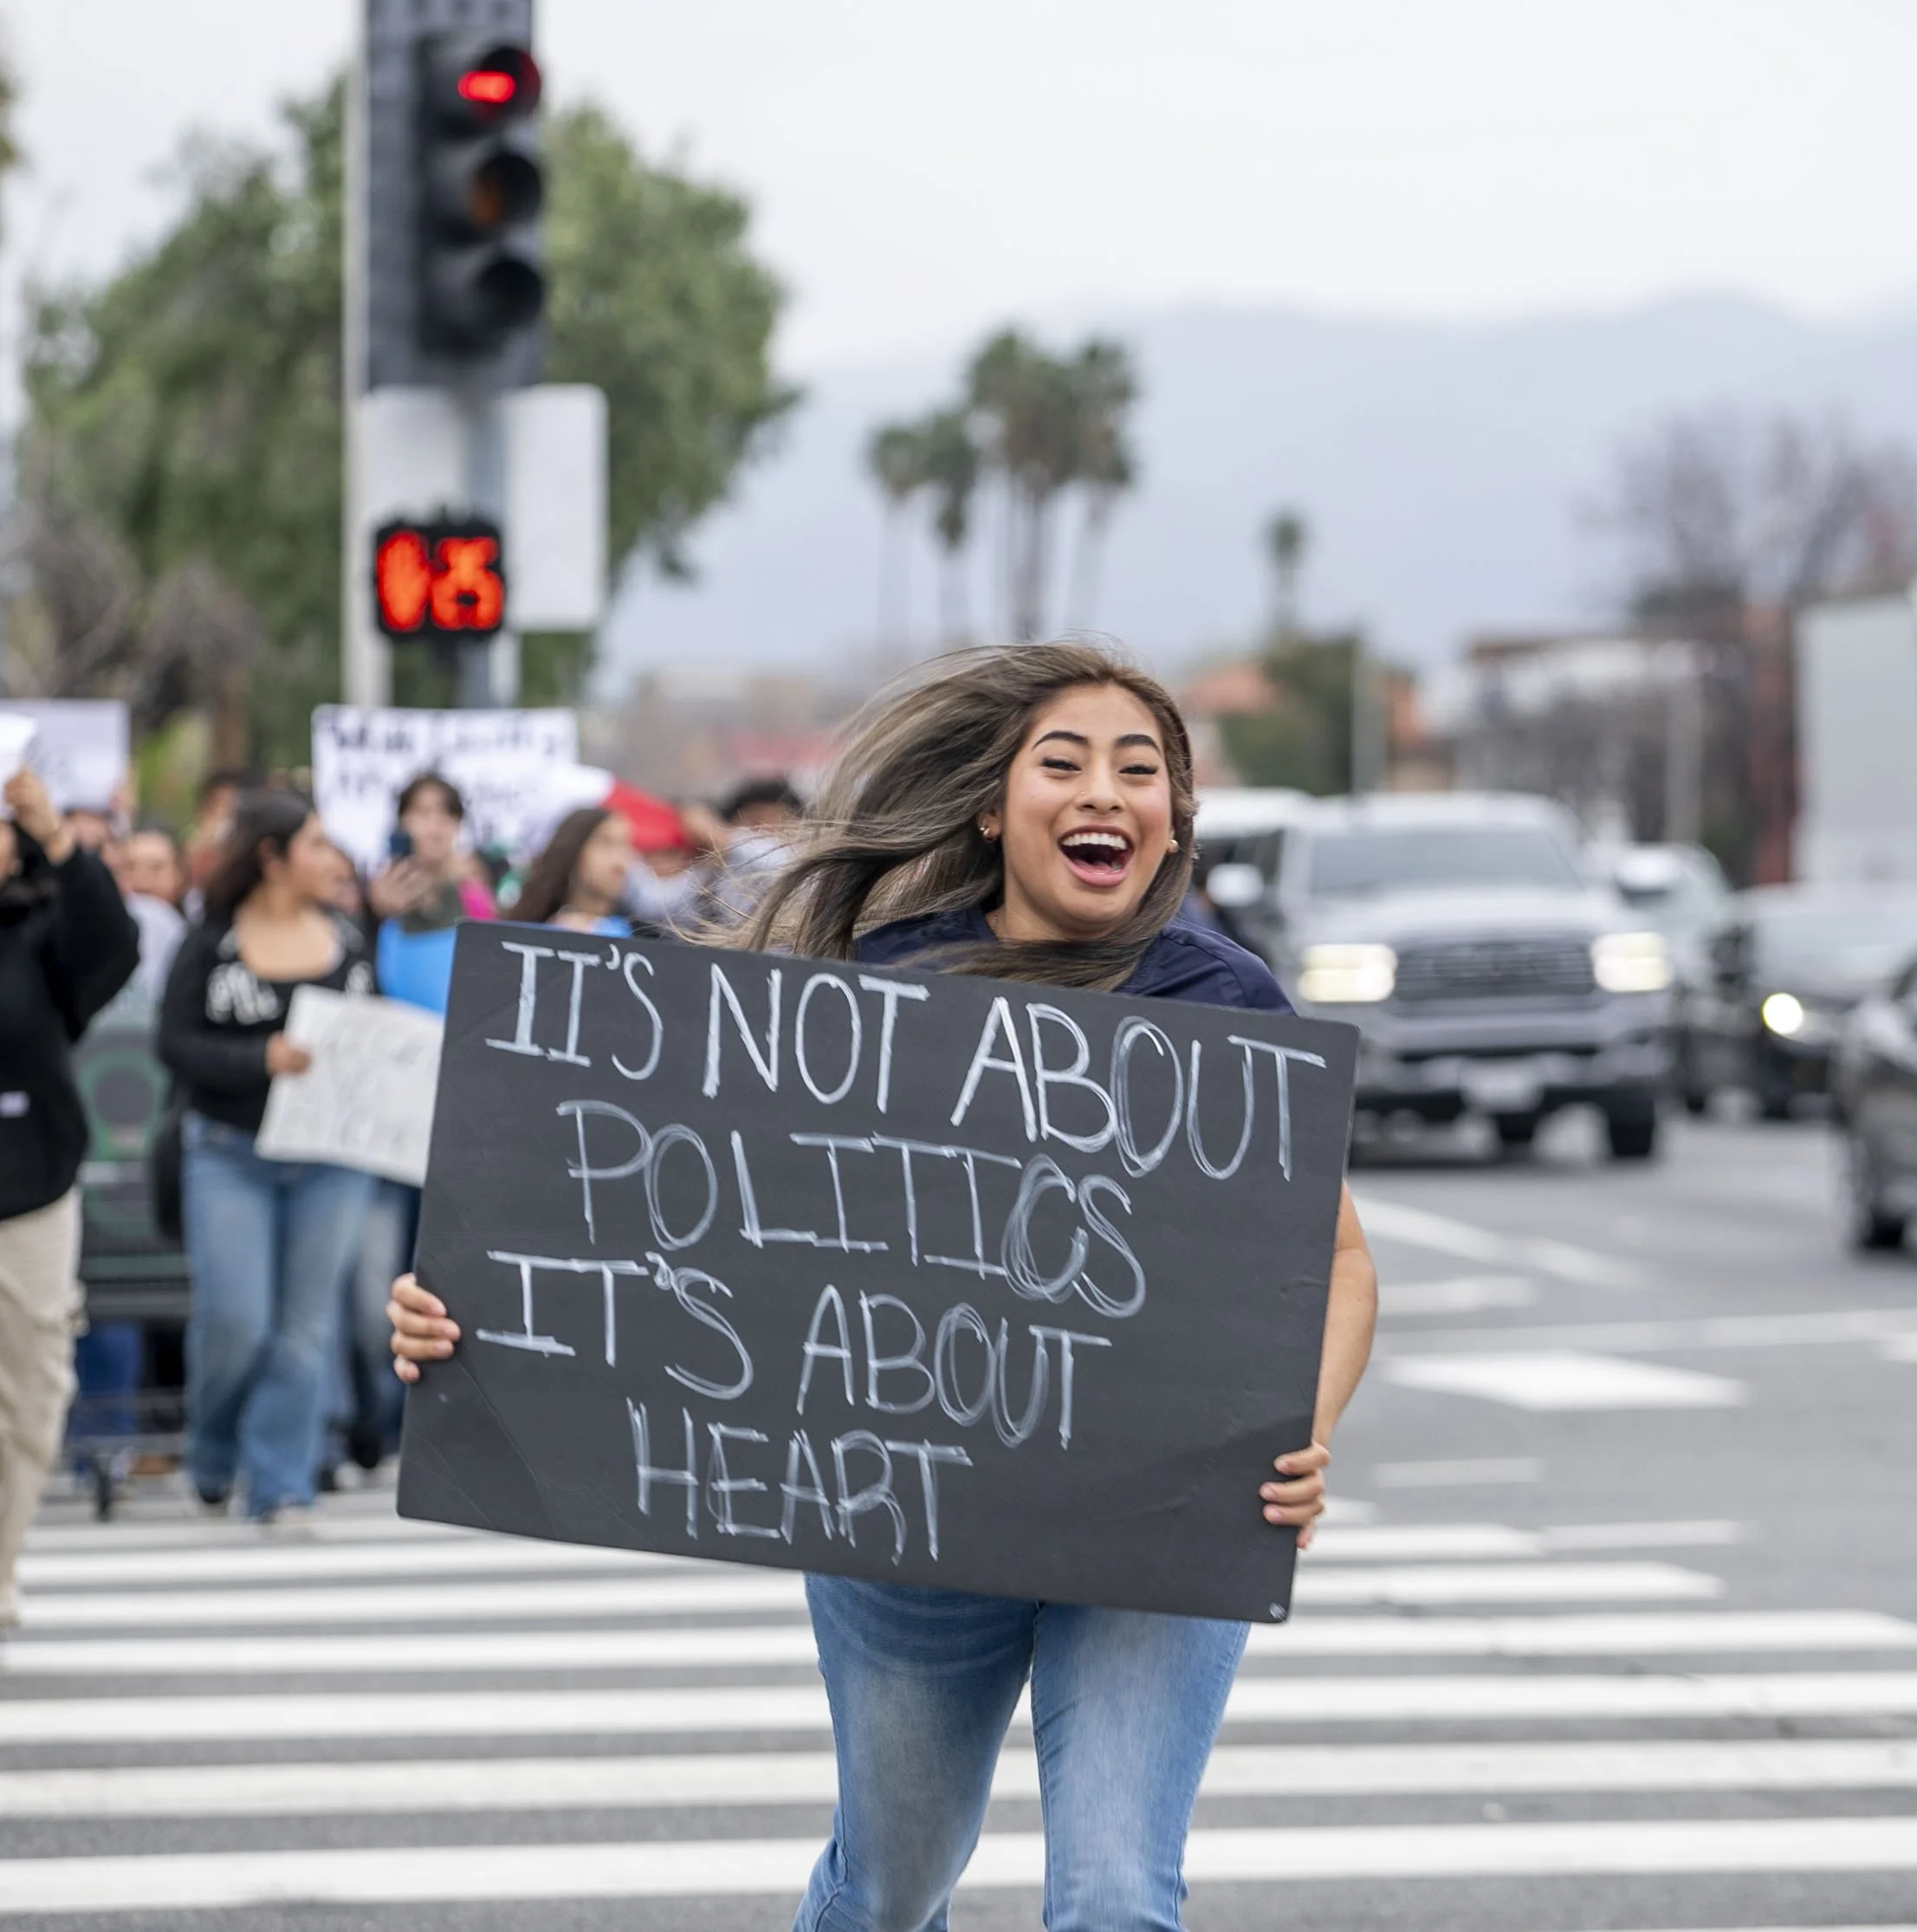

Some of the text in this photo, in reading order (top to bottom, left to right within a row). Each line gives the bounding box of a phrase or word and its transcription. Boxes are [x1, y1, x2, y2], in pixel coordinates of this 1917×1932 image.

[485, 941, 663, 1080] IT'S
[702, 962, 930, 1114] NOT
[951, 995, 1327, 1181] ABOUT
[555, 1099, 1147, 1319] POLITICS
[476, 1250, 1112, 1450] IT'S ABOUT
[626, 1397, 974, 1566] HEART
